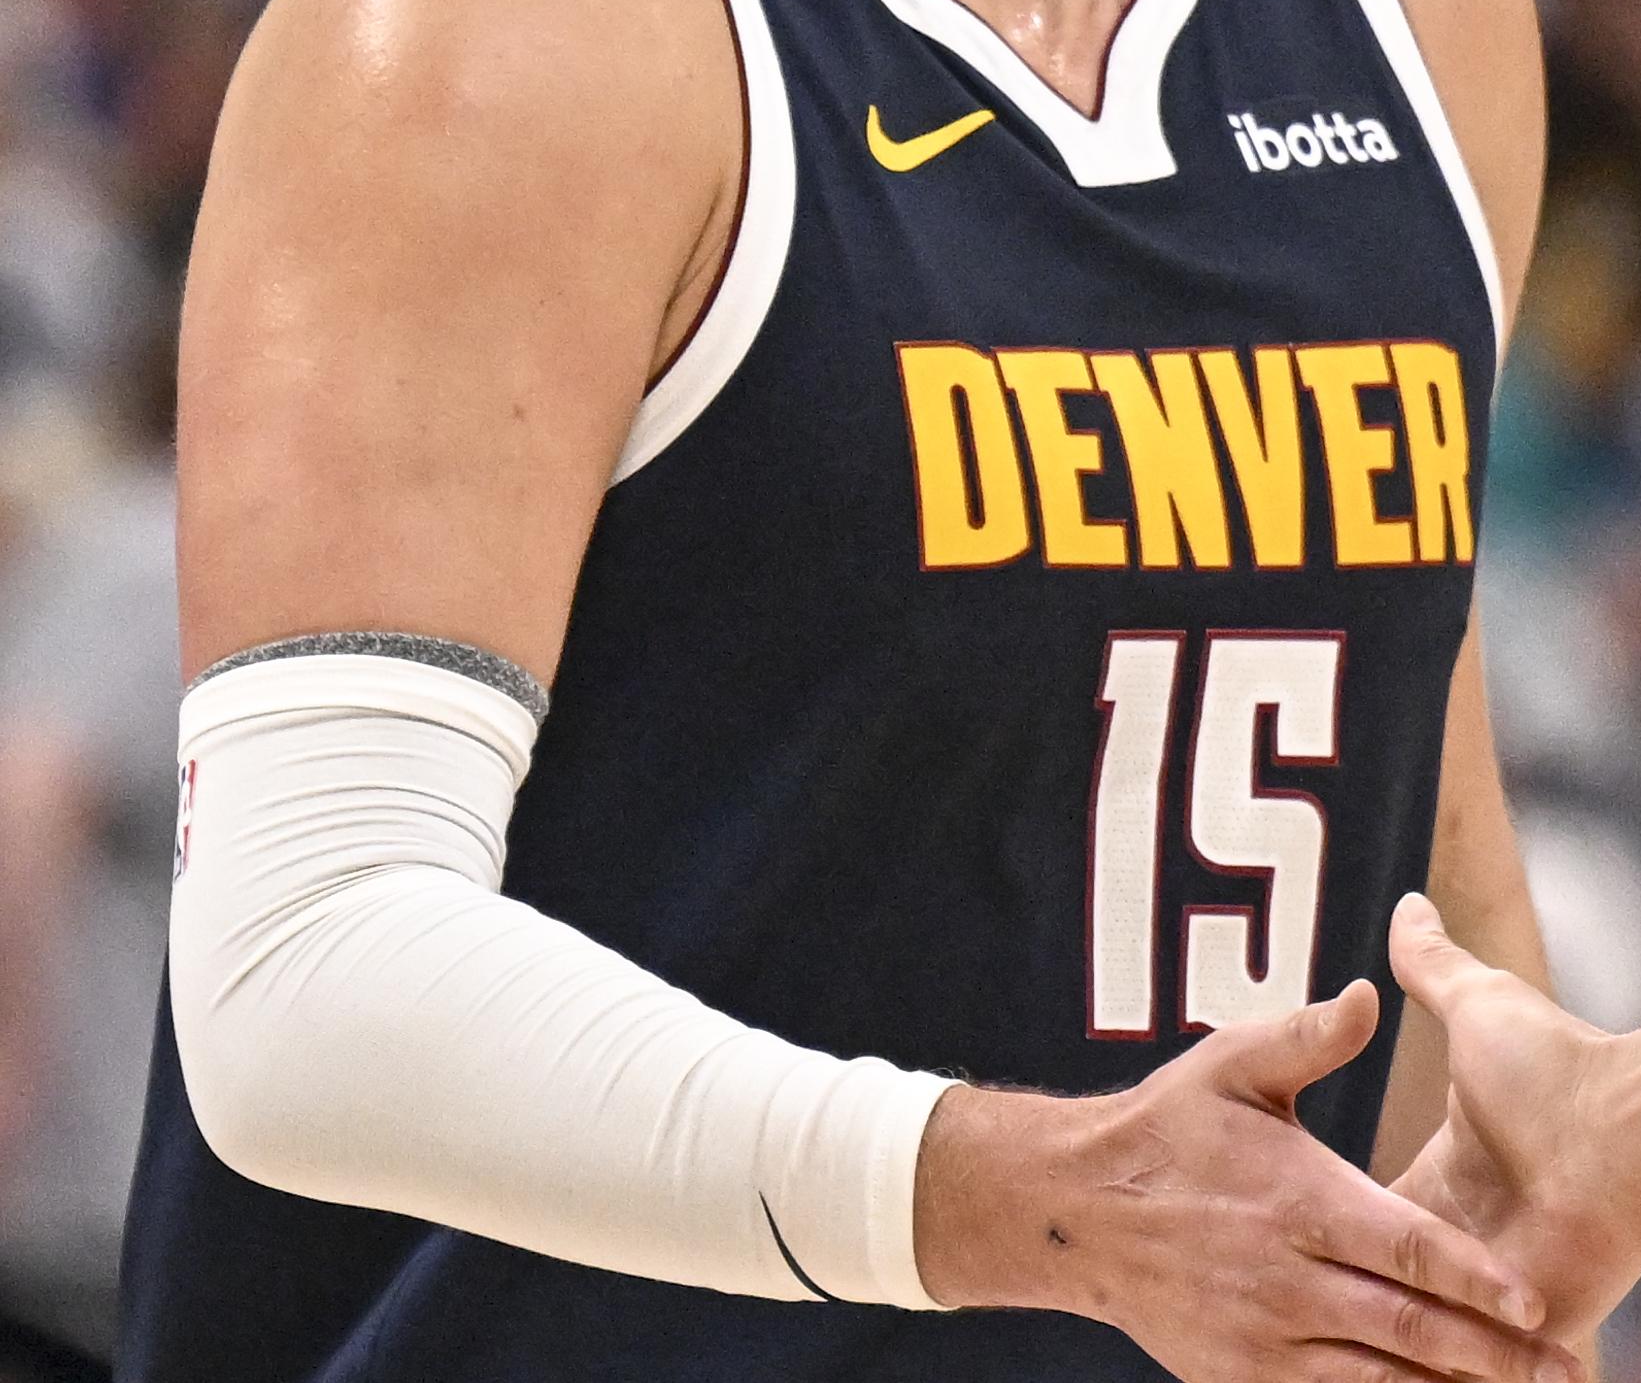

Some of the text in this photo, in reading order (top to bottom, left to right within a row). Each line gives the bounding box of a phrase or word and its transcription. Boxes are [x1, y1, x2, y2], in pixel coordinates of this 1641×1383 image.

[1226, 111, 1400, 173] ibotta
[894, 340, 1475, 571] DENVER
[1085, 628, 1347, 1040] 15
